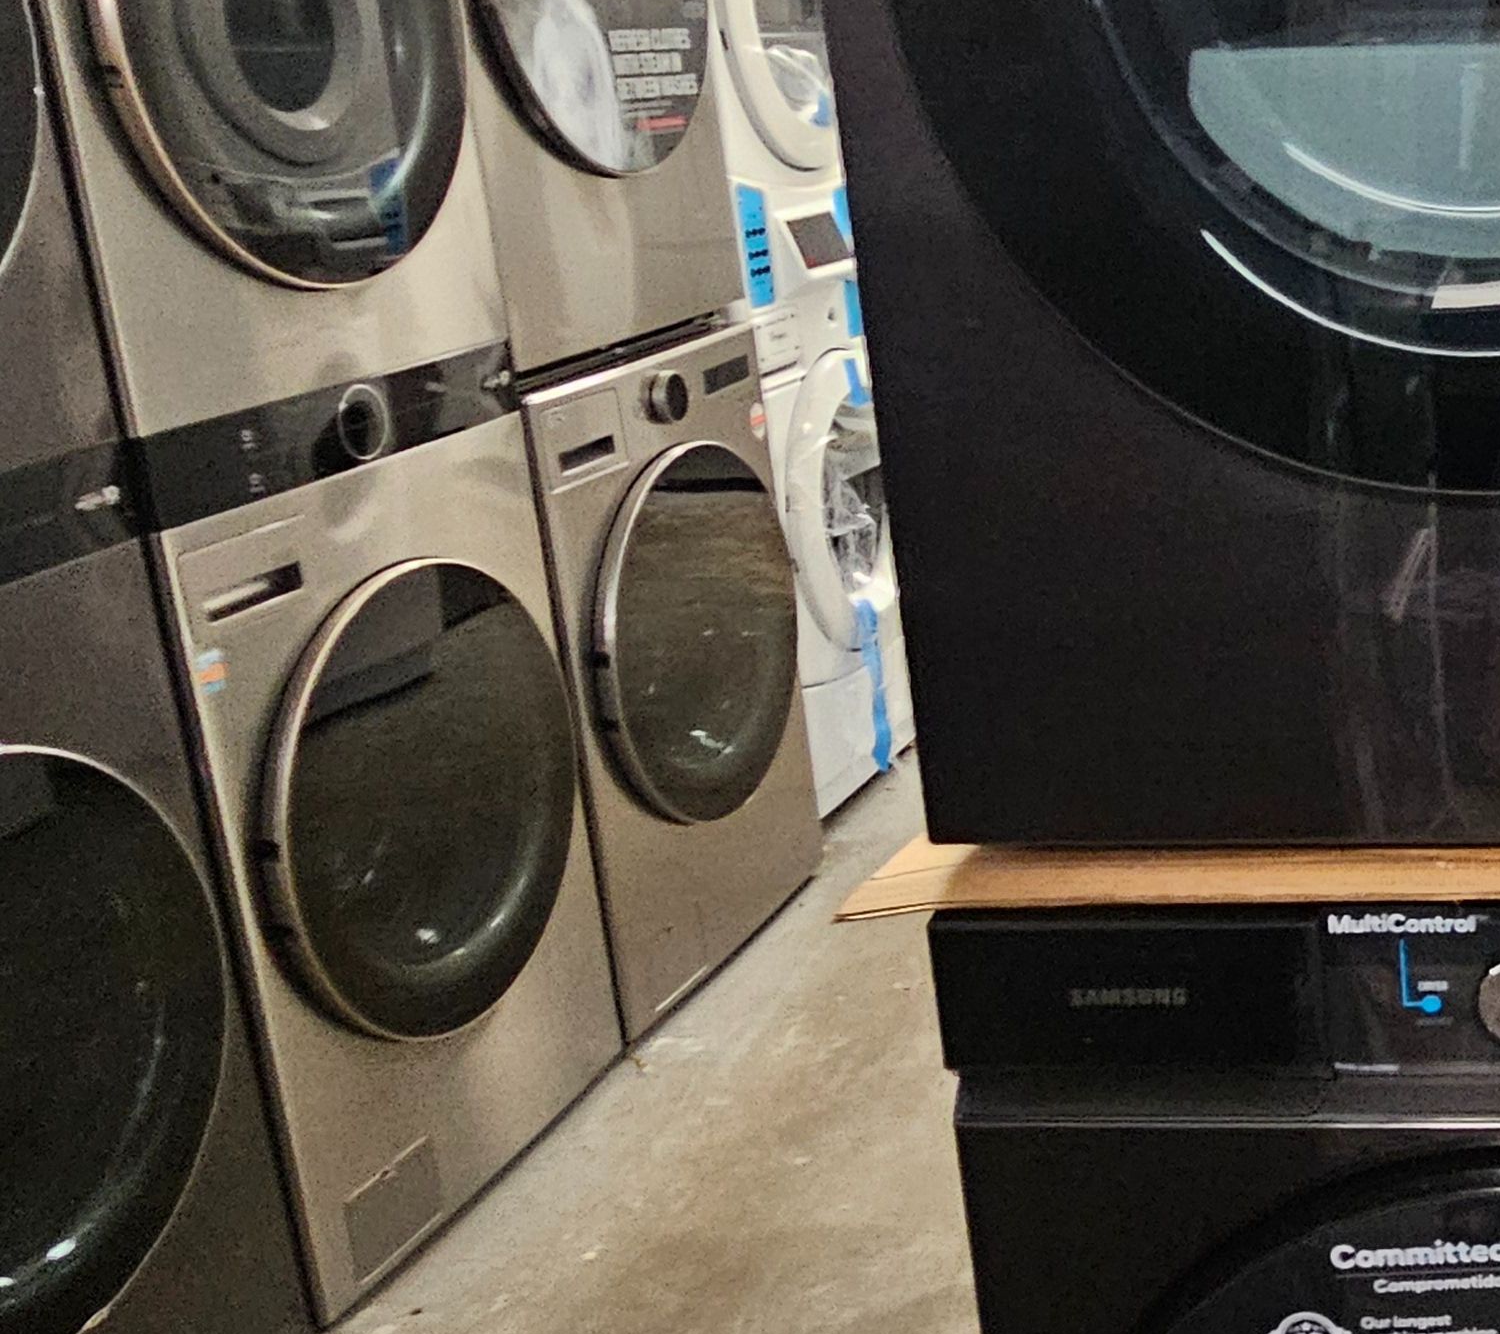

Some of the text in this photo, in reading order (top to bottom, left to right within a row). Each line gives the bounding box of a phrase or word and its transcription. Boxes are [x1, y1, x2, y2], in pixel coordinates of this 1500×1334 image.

[1070, 986, 1188, 1008] SAMSUNG
[1360, 1314, 1453, 1330] Our longest
